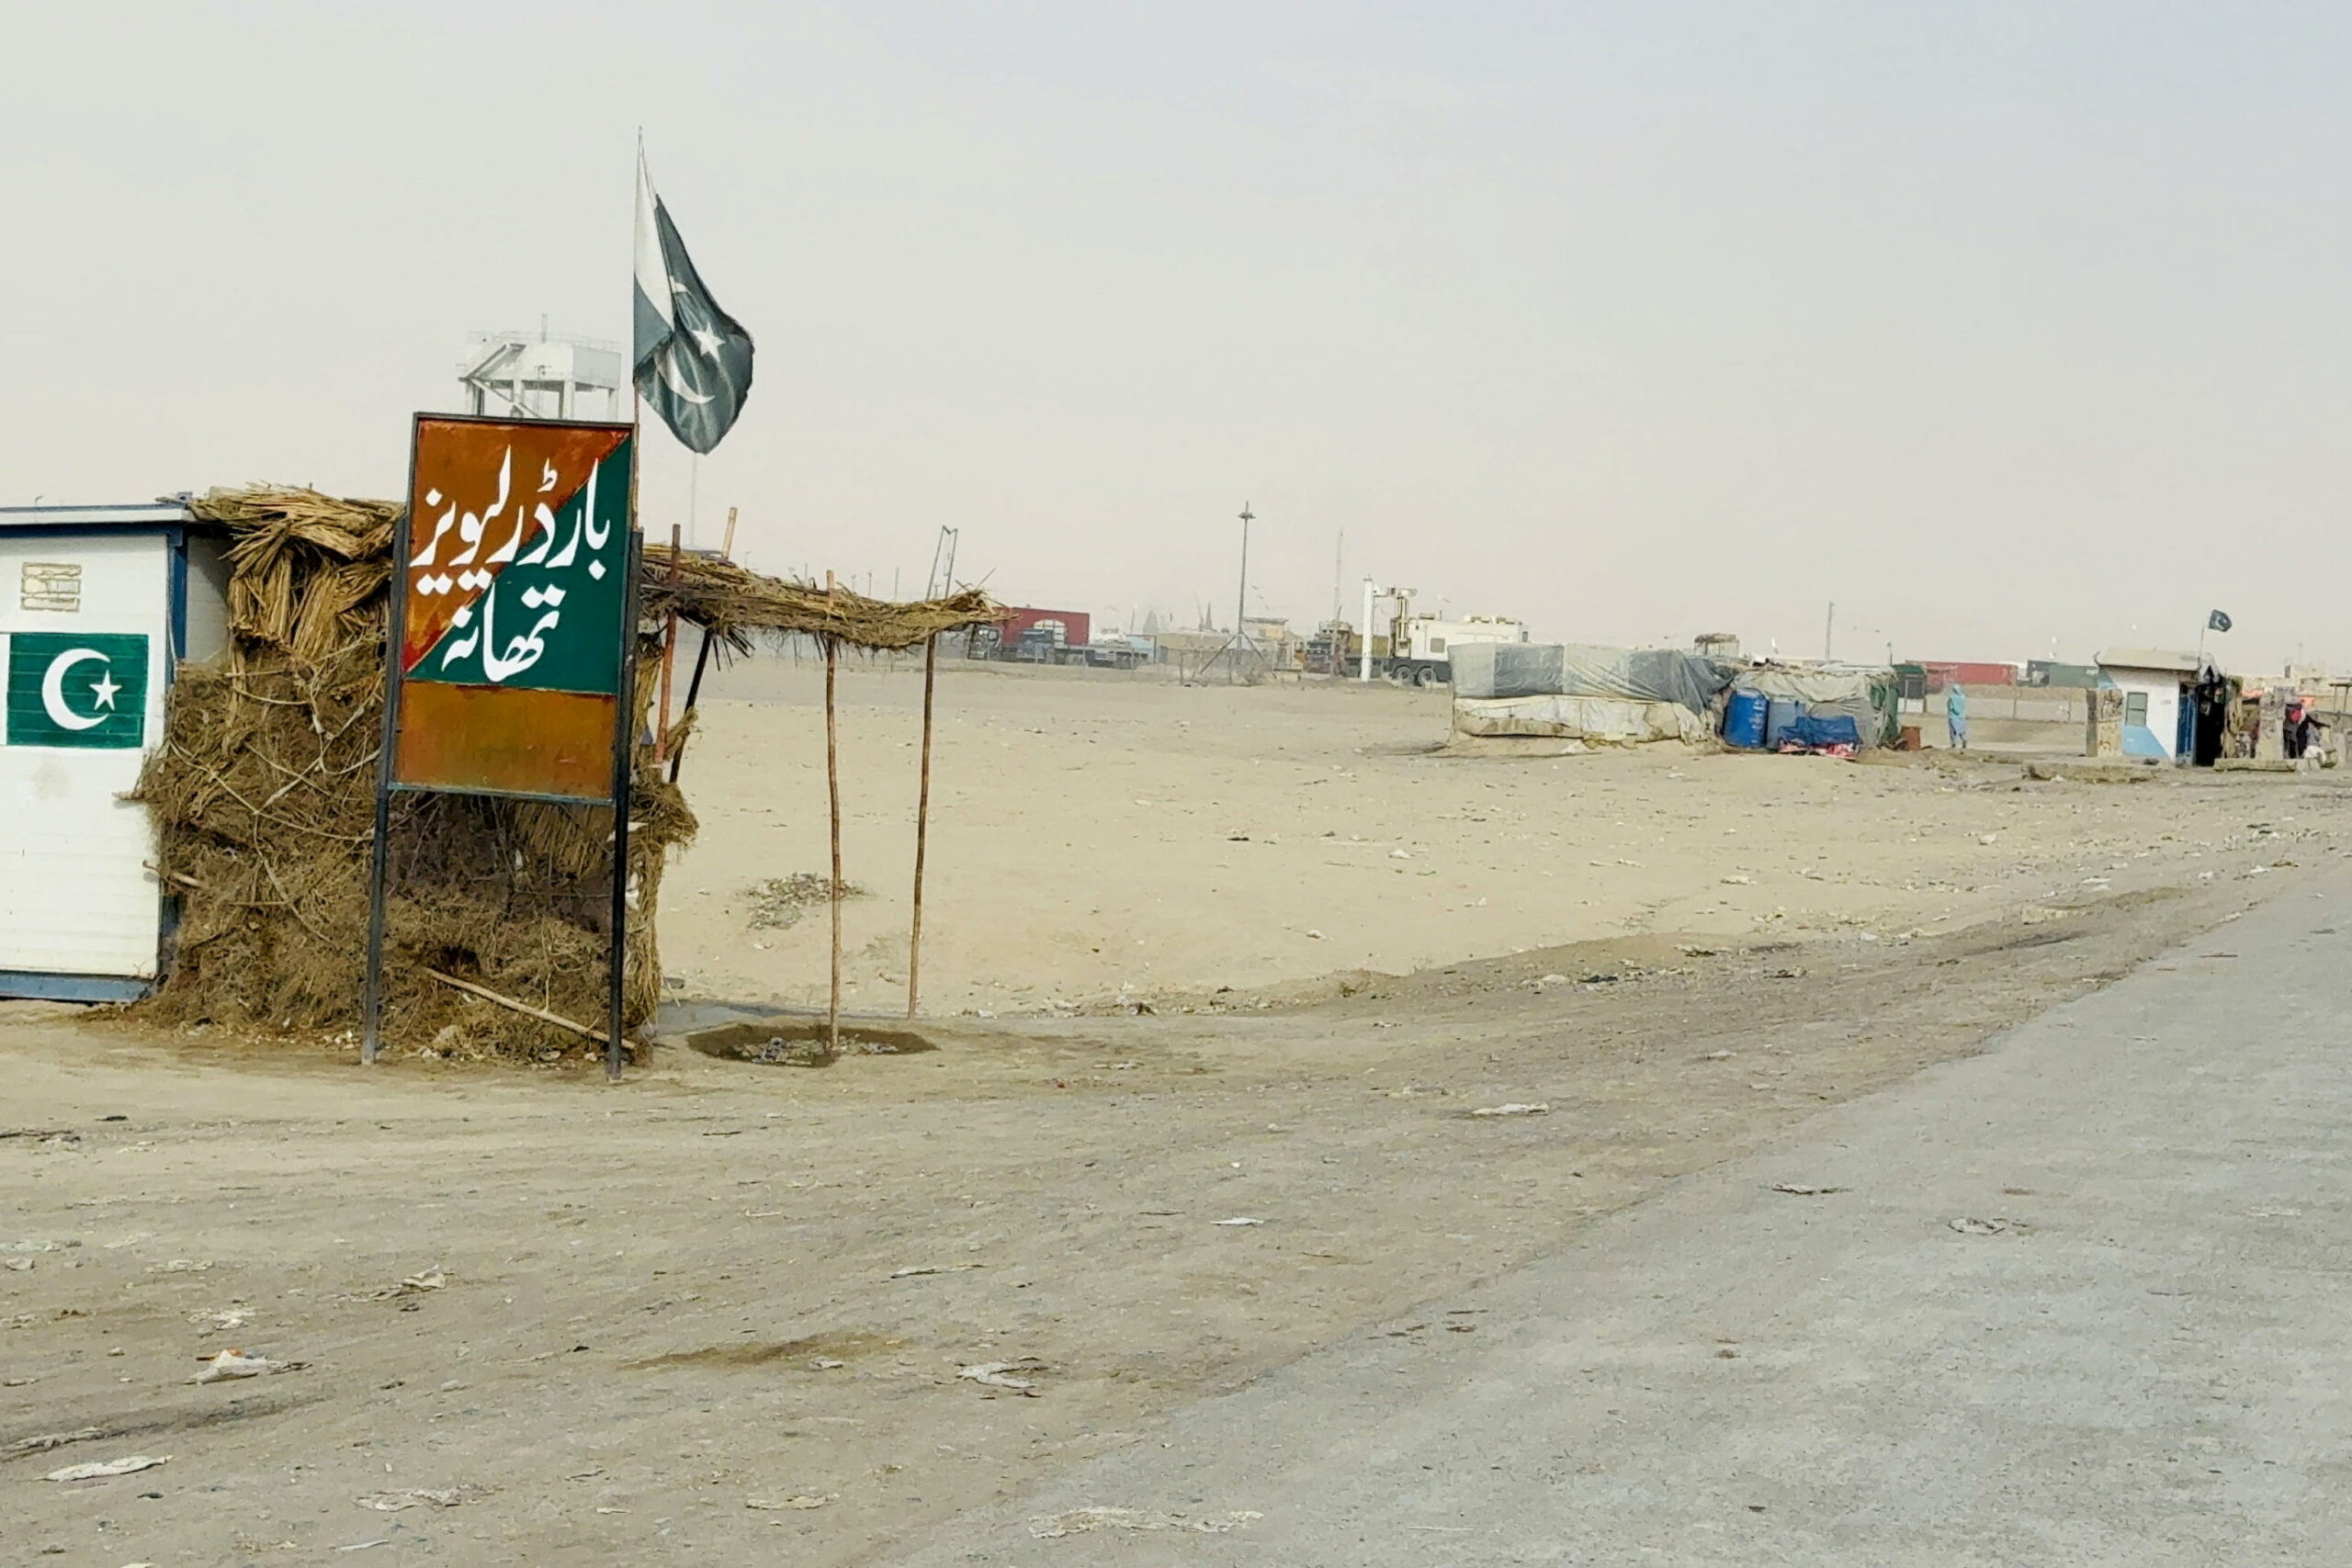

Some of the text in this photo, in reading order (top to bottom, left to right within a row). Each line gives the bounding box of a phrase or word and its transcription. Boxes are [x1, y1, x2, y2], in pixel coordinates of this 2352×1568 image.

[409, 445, 611, 595] بارڈر لیویز
[441, 582, 566, 682] تھانہ
